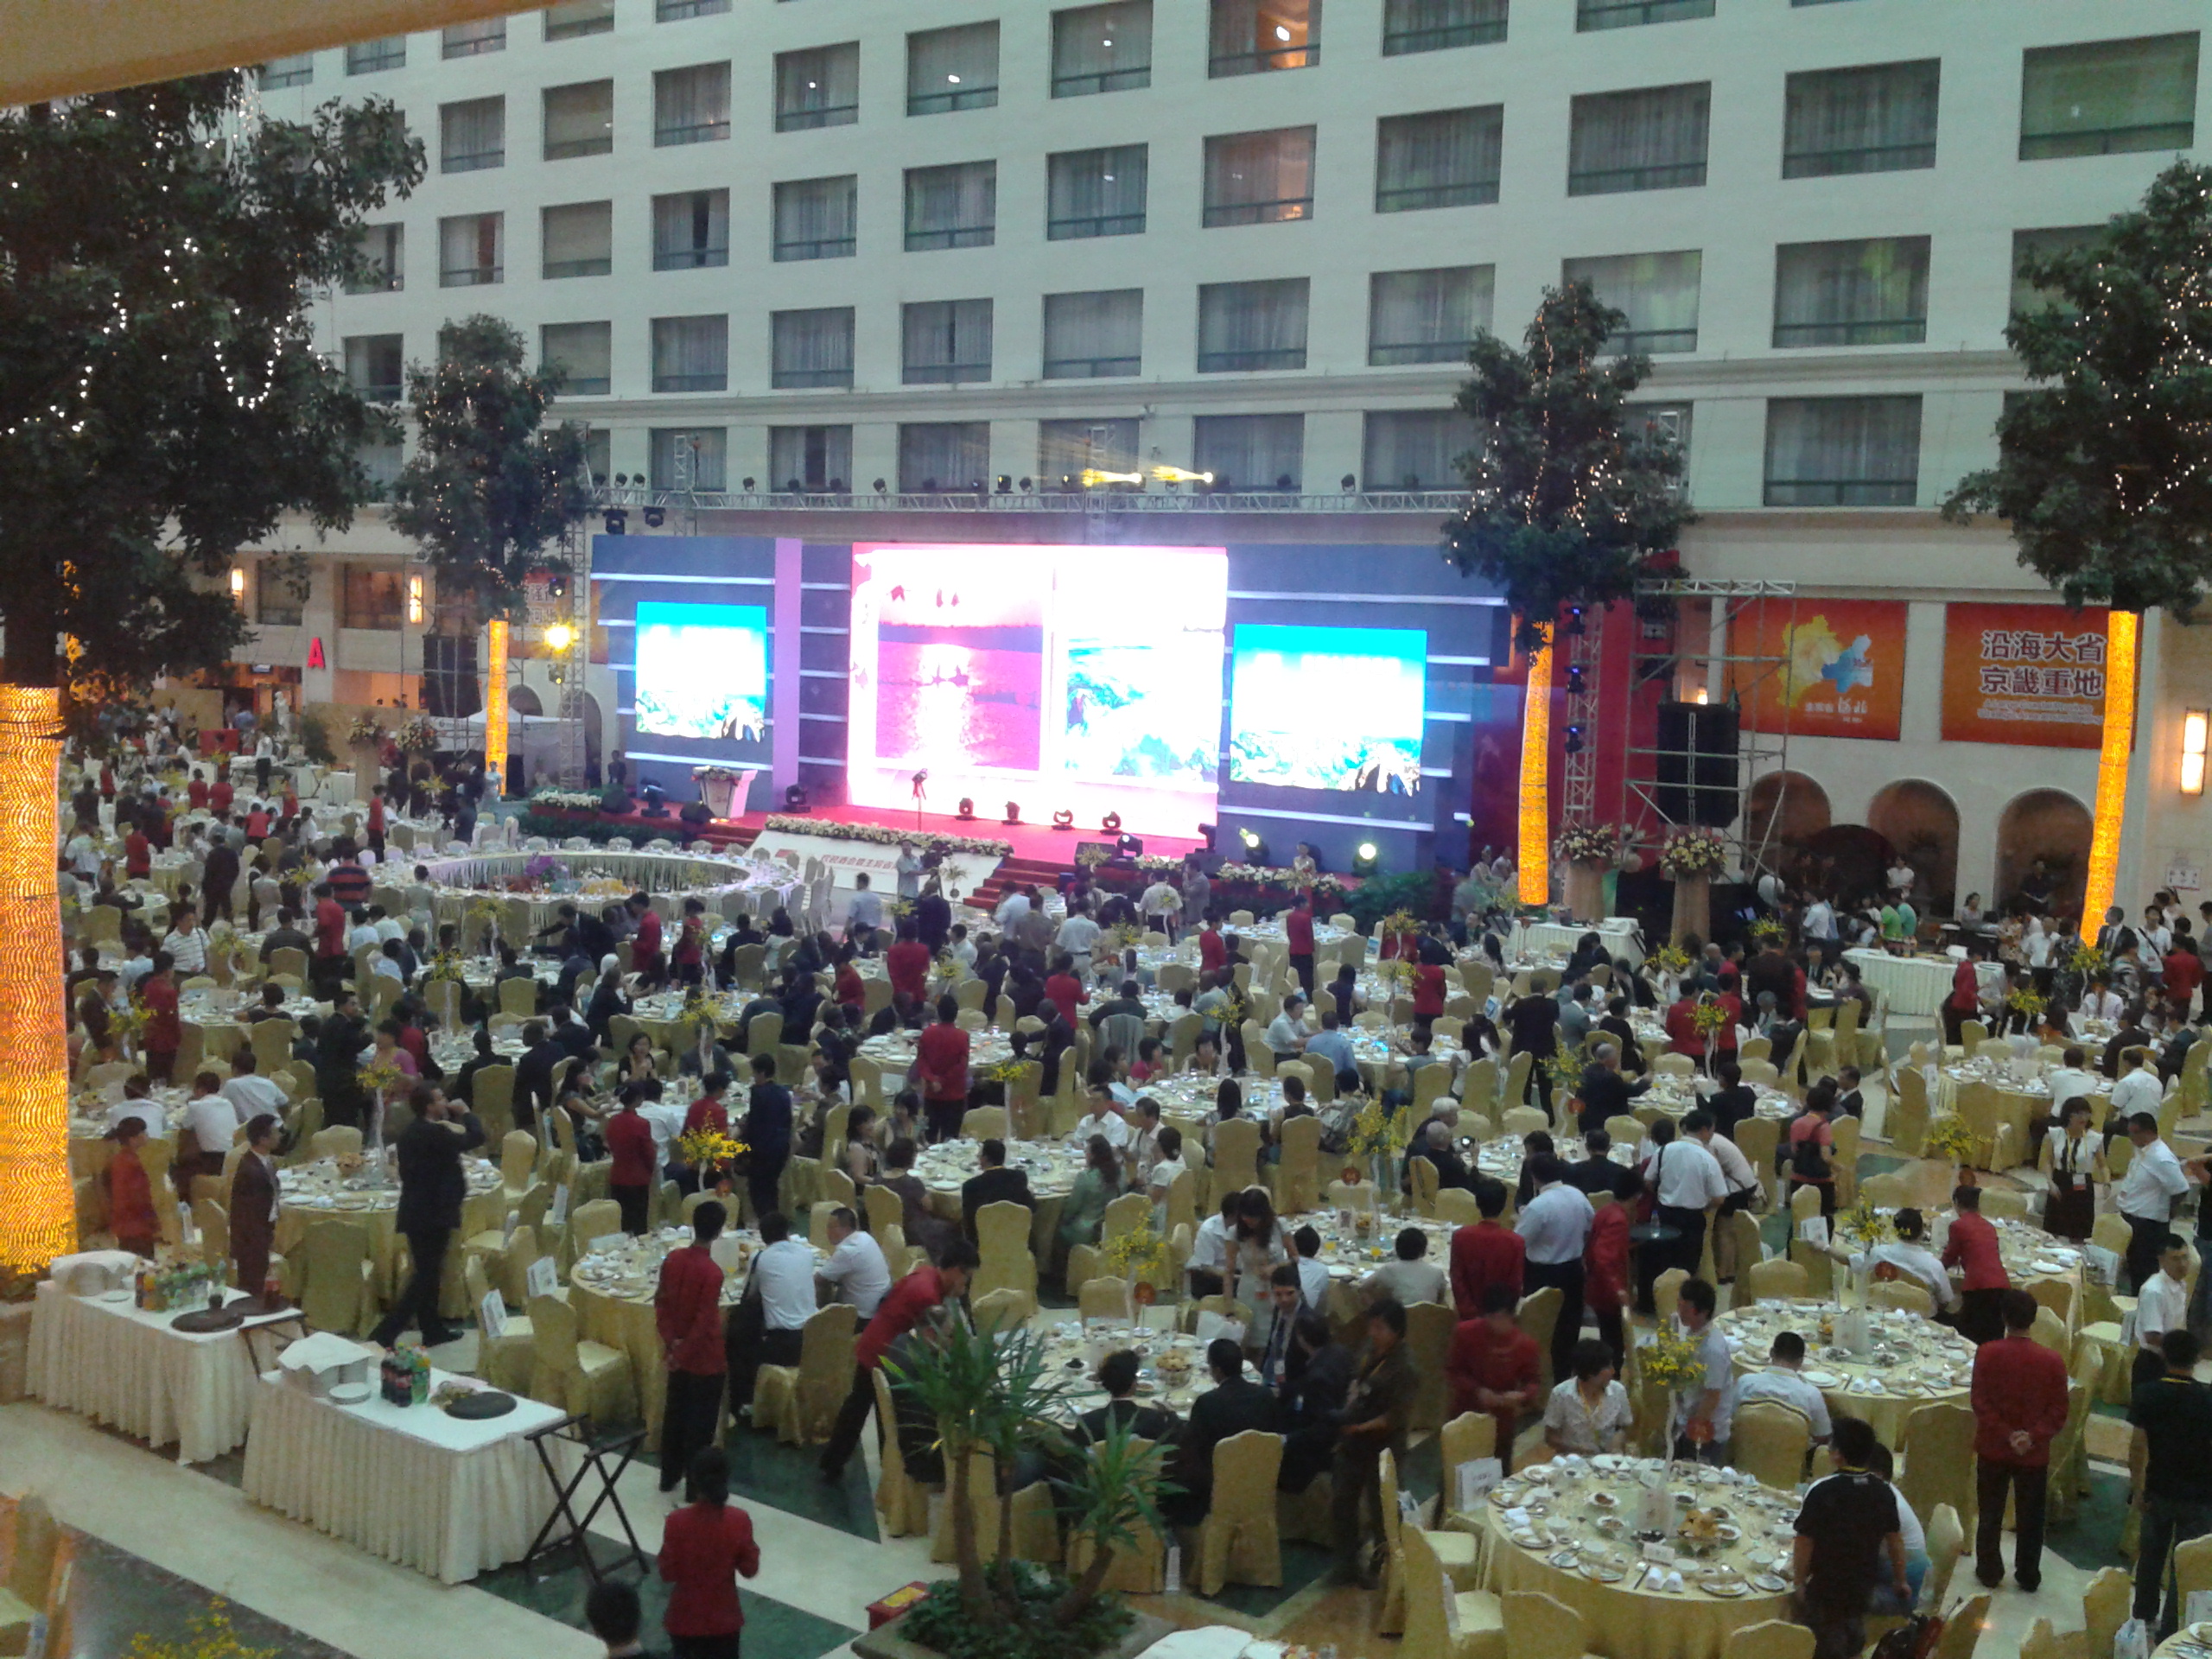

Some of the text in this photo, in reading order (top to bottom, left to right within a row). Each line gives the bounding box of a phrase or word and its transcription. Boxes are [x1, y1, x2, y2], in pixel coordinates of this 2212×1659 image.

[306, 637, 326, 669] A
[1981, 631, 2106, 663] 沿海大省
[1980, 665, 2103, 697] 京畿重地
